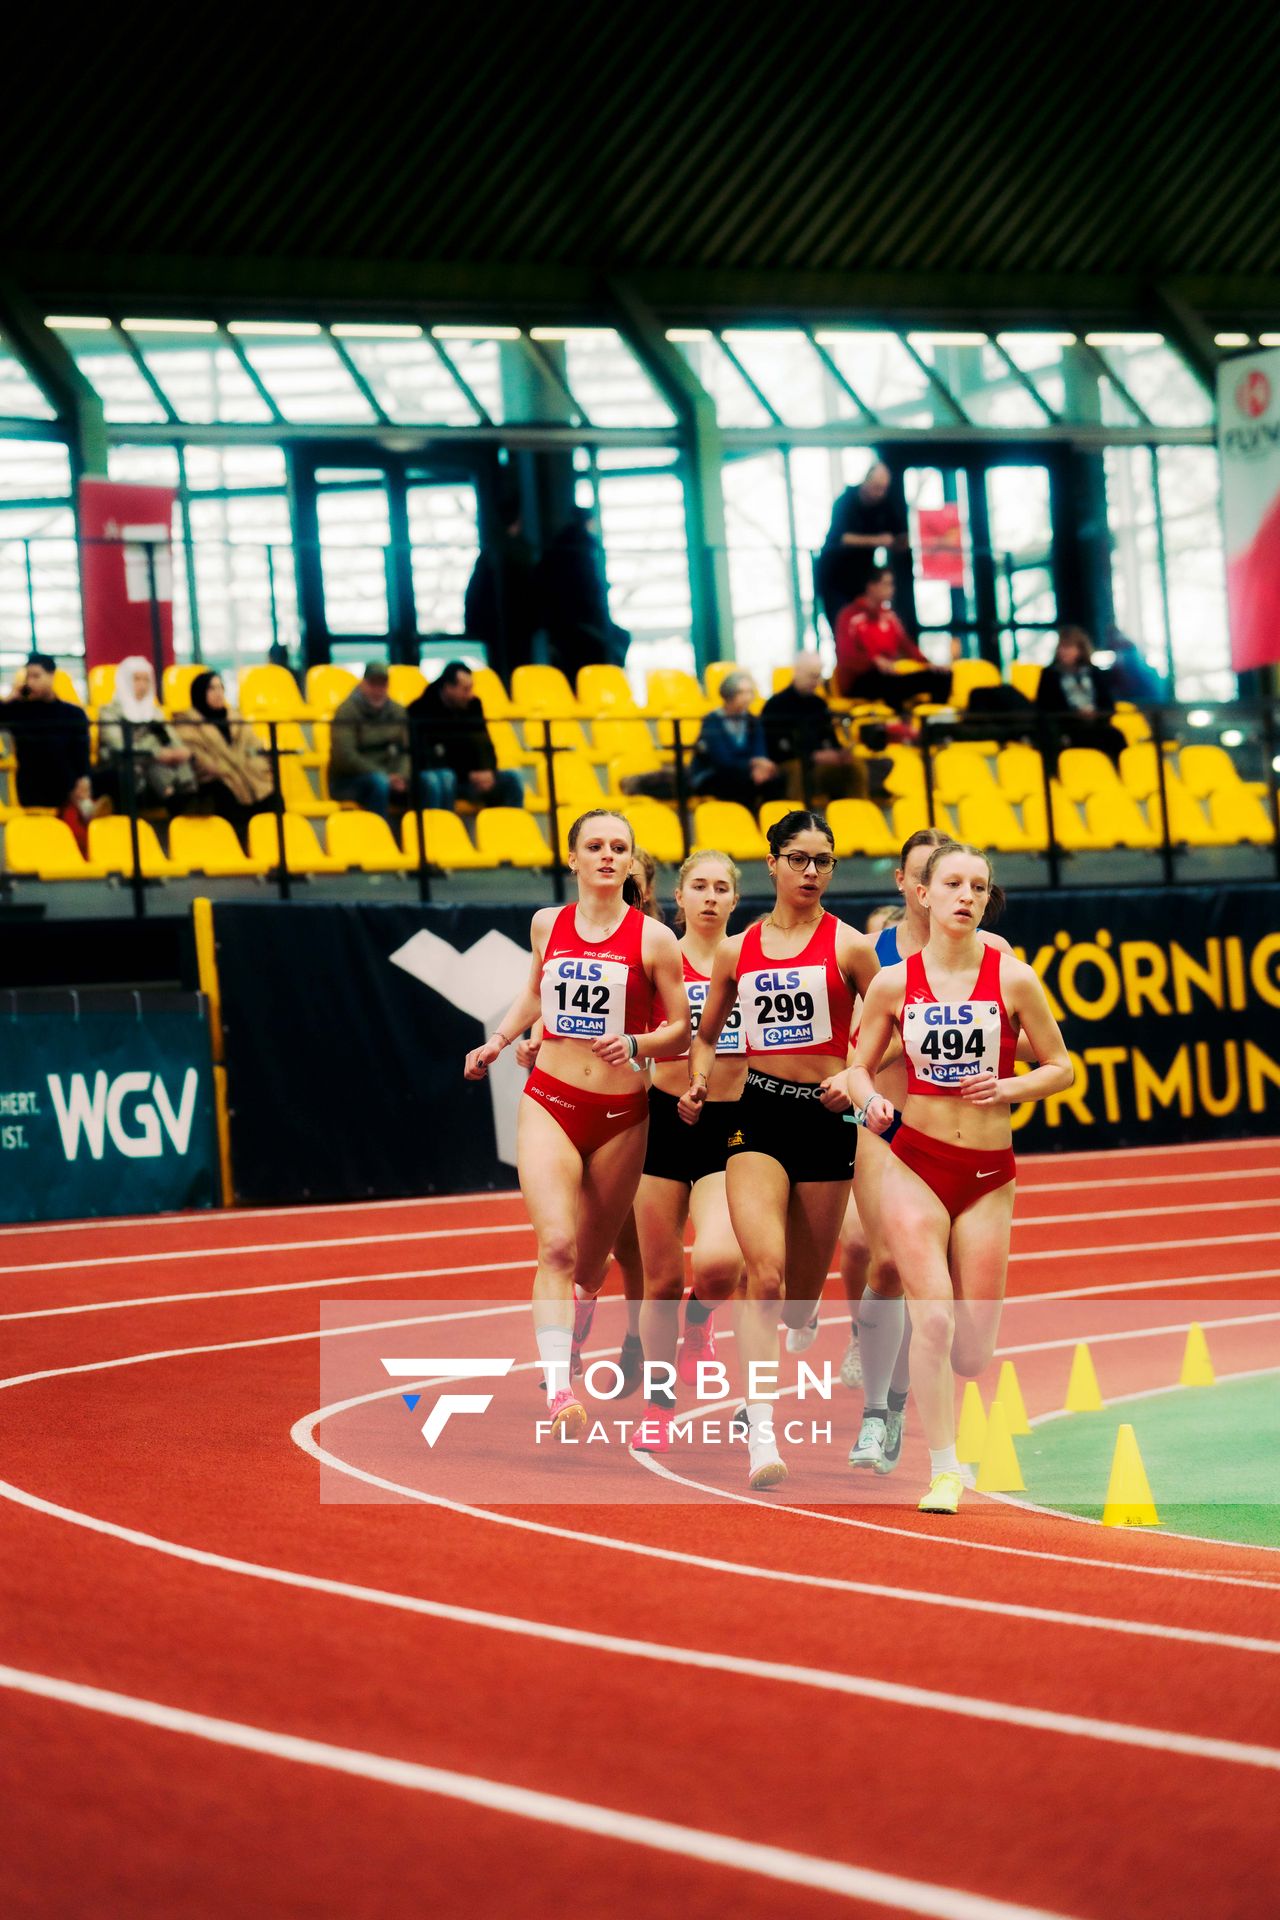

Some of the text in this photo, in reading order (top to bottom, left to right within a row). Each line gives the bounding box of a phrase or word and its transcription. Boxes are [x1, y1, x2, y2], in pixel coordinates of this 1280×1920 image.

[554, 981, 610, 1014] 142
[754, 991, 814, 1025] 299
[575, 1019, 604, 1030] PLAN
[717, 1034, 738, 1044] LAN
[782, 1027, 811, 1038] PLAN
[920, 1028, 986, 1060] 494
[948, 1064, 979, 1076] PLAN
[531, 1086, 545, 1097] PRO
[780, 1084, 828, 1099] PRO
[47, 1067, 198, 1161] WGV
